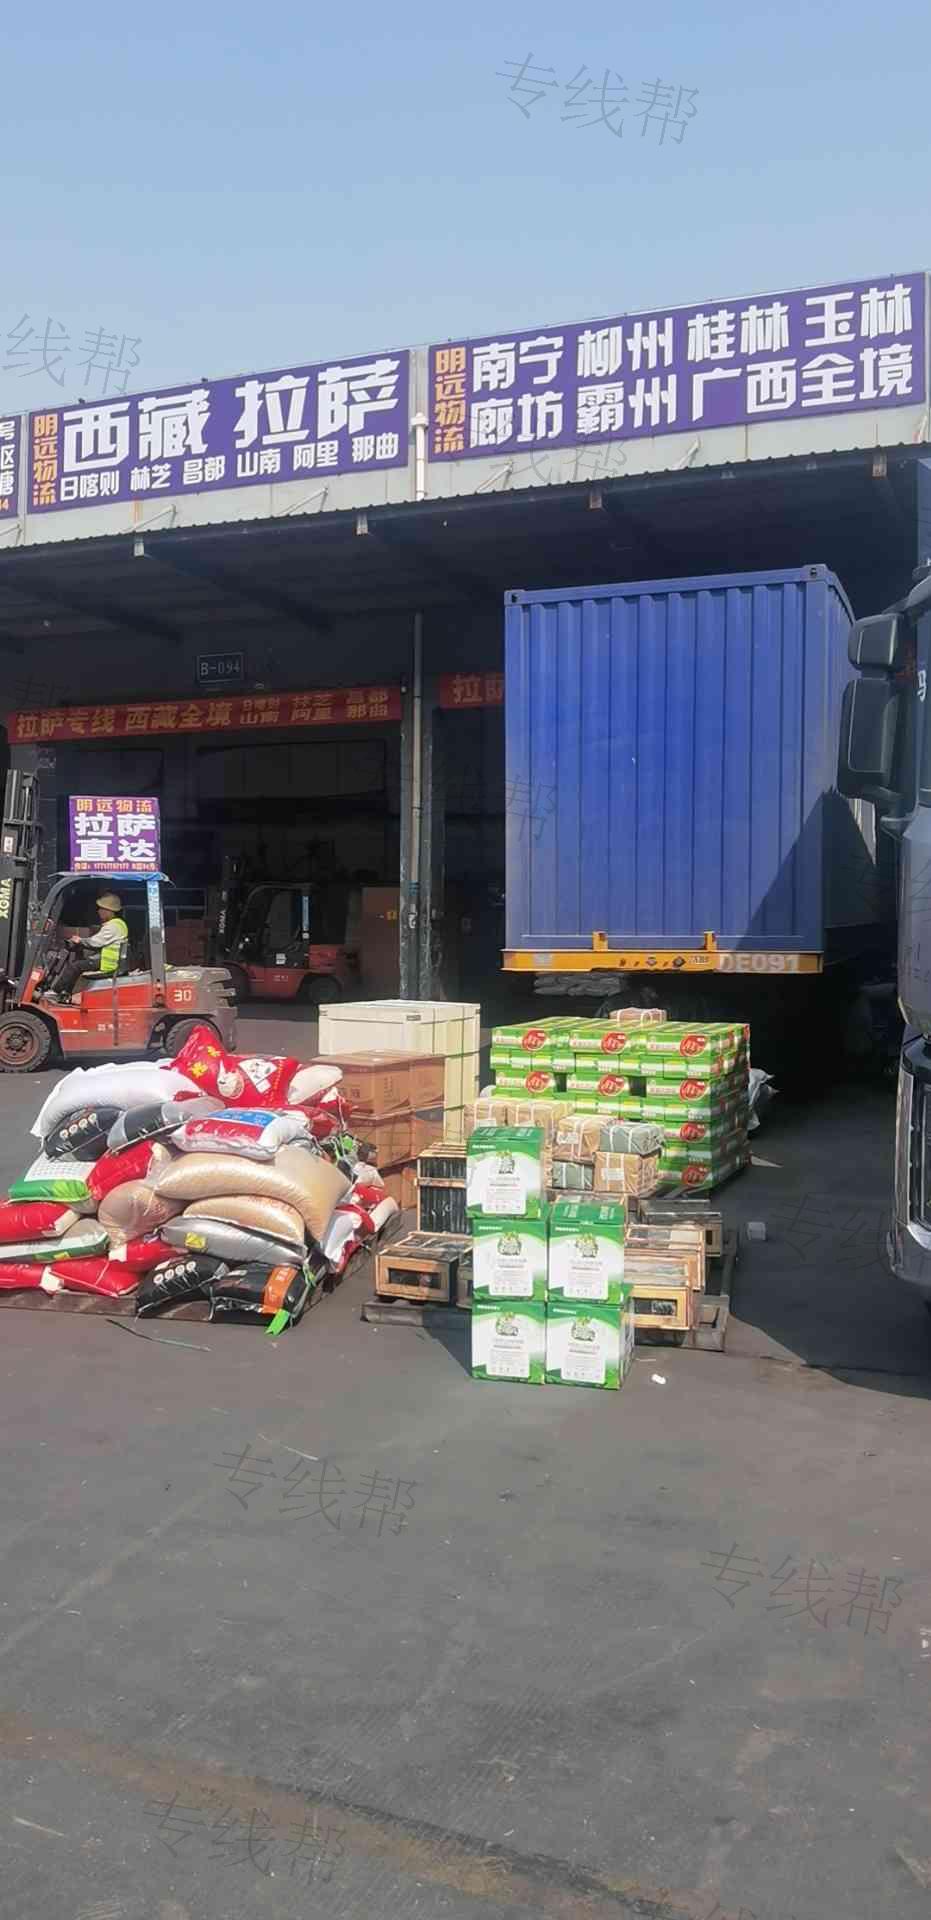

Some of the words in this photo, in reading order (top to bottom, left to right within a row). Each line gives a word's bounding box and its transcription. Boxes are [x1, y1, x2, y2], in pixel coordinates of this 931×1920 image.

[472, 335, 564, 393] 南宁
[576, 317, 675, 379] 柳州
[687, 301, 790, 363] 桂林
[804, 283, 913, 348] 玉林
[62, 389, 211, 473] 西藏
[233, 358, 401, 449] 拉萨
[434, 346, 466, 455] 明远物流
[470, 391, 564, 448] 廊坊
[576, 374, 677, 436] 霸州
[692, 343, 914, 421] 广西全境
[33, 414, 58, 506] 明远物流
[60, 469, 120, 502] 日喀则
[130, 463, 172, 492] 林芝
[182, 455, 226, 486] 昌都
[236, 448, 281, 477] 山南
[293, 440, 339, 470] 阿里
[351, 432, 399, 463] 那曲
[200, 660, 241, 677] B-094
[16, 708, 116, 738] 拉萨专线
[125, 701, 233, 731] 西藏全境
[74, 813, 156, 837] 拉萨
[77, 799, 152, 812] 明远物流
[74, 838, 157, 862] 直达
[173, 988, 192, 1002] 30
